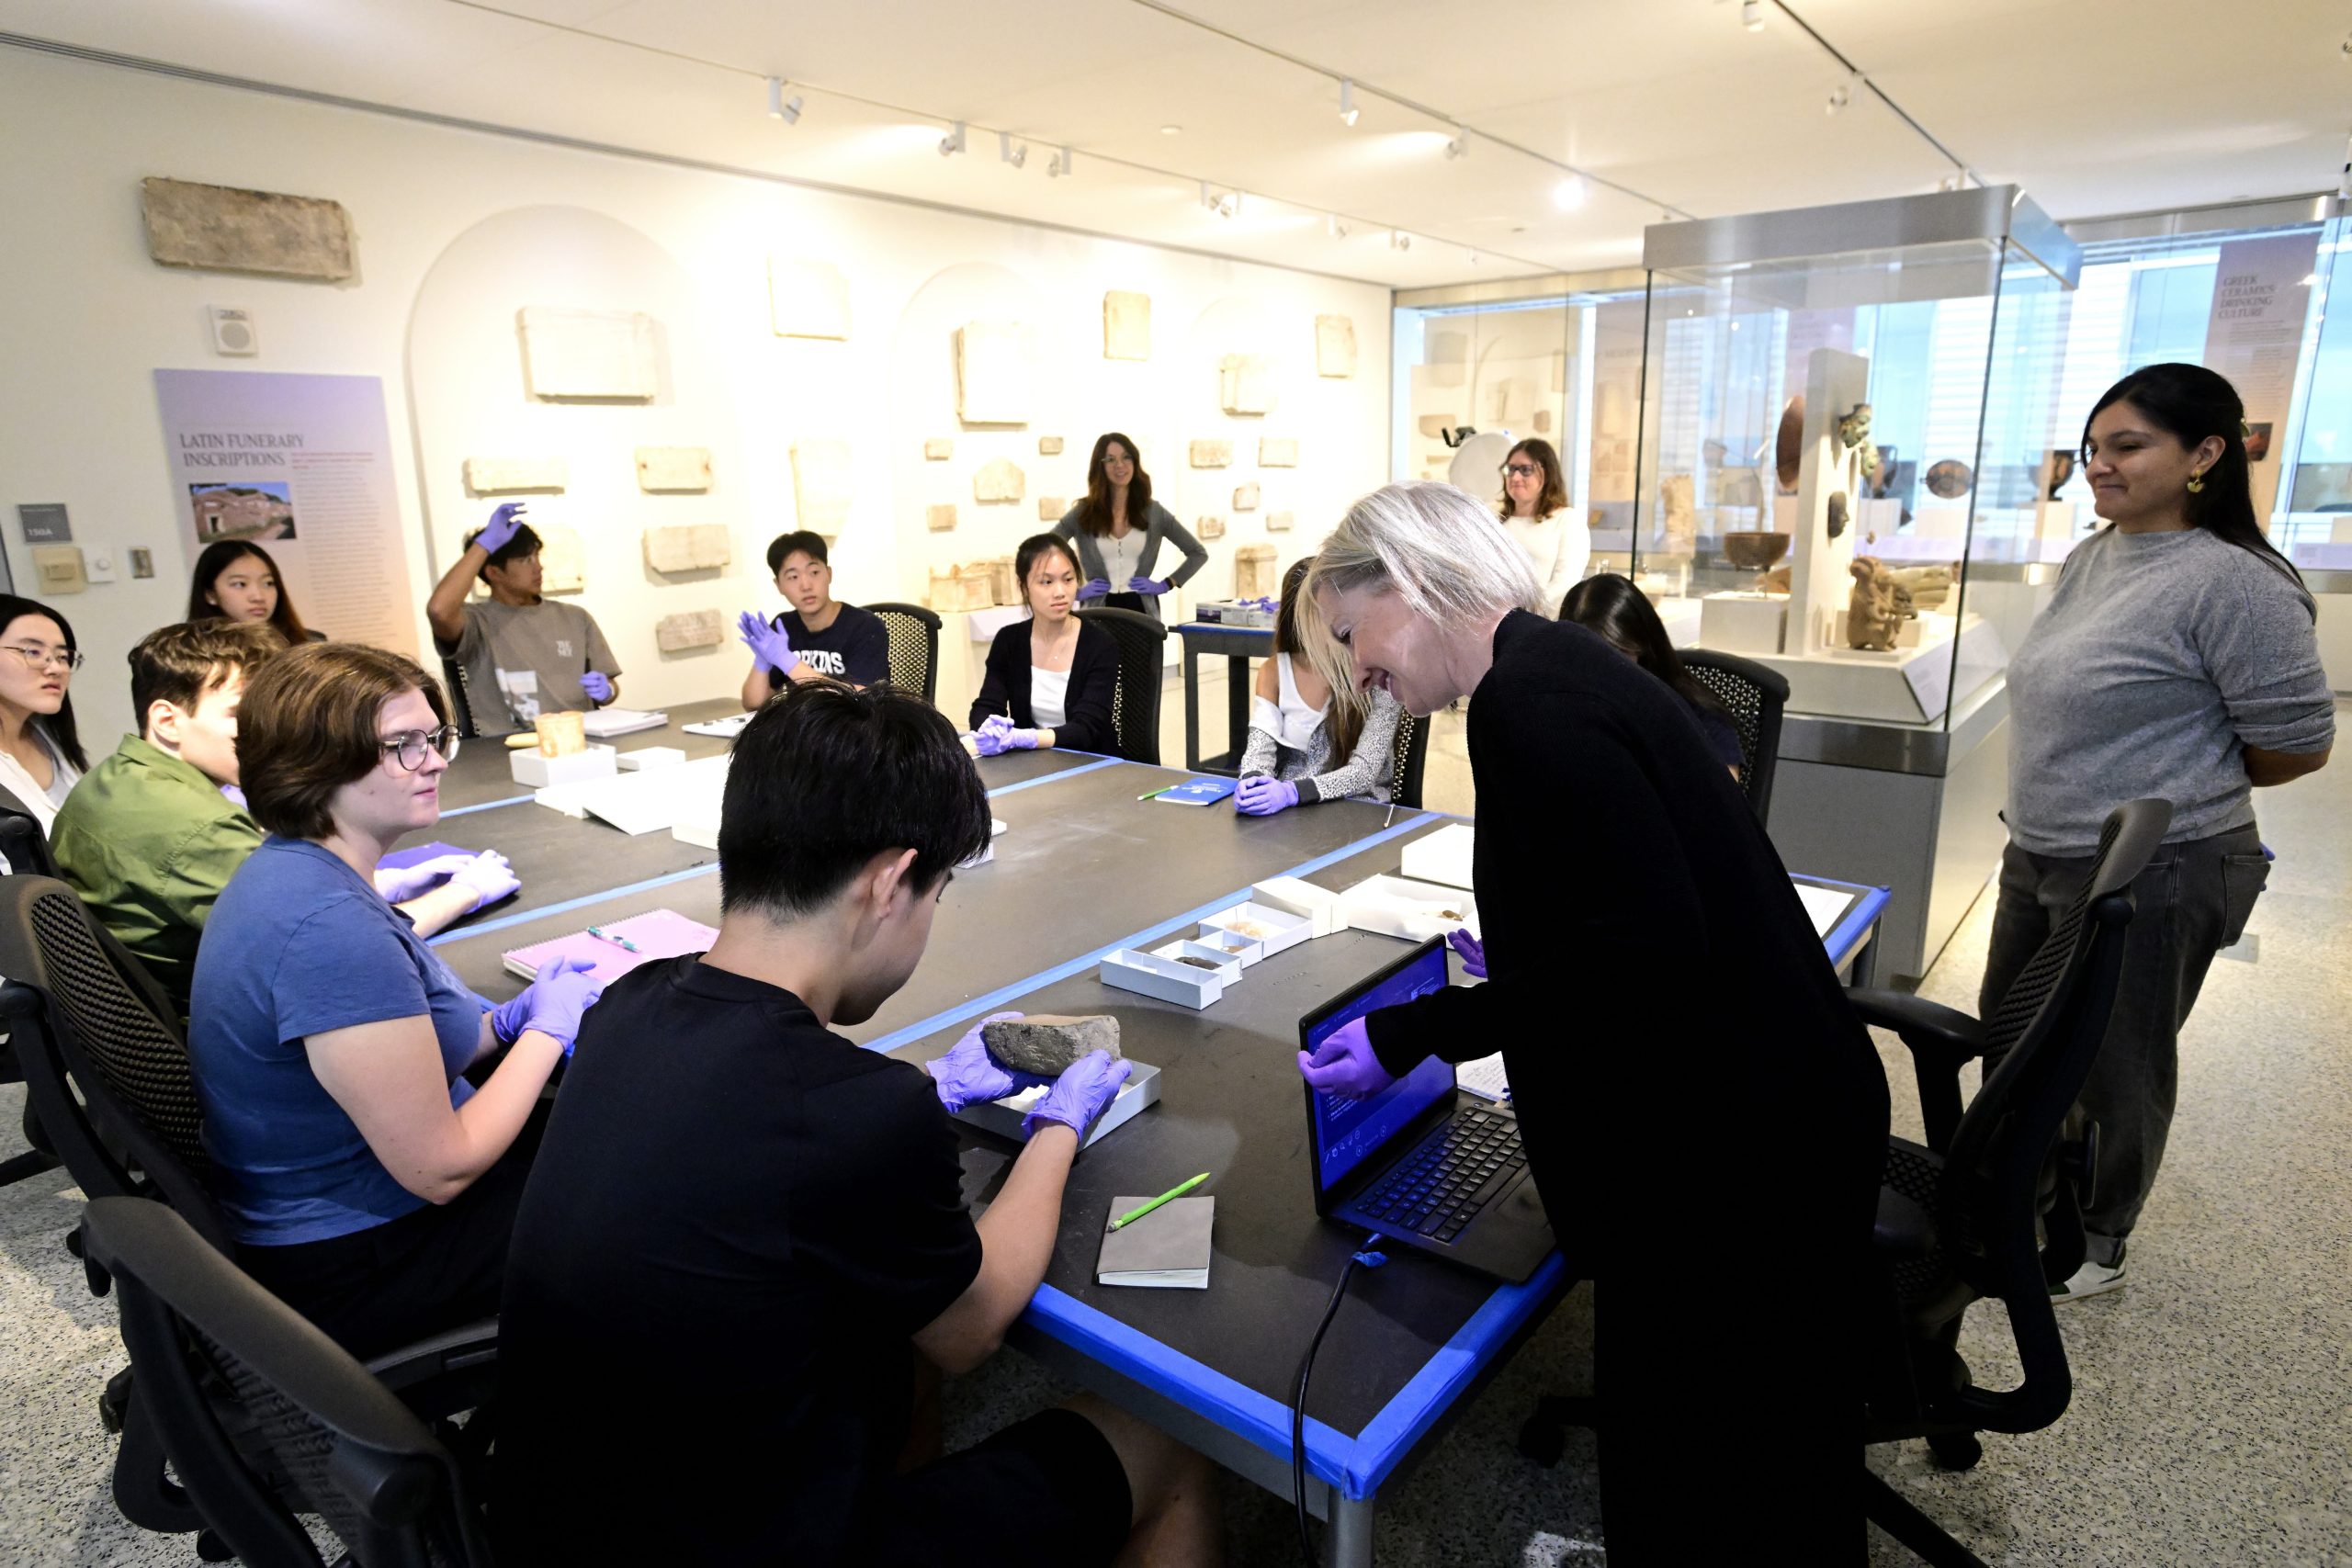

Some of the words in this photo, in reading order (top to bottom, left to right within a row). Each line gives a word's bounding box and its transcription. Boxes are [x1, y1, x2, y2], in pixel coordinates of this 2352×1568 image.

[2223, 275, 2258, 287] GREEK
[2220, 295, 2273, 309] DRINKING
[2218, 307, 2264, 320] CULTURE
[179, 433, 224, 448] LATIN
[226, 434, 304, 448] FUNERARY
[183, 452, 286, 467] INSCRIPTIONS
